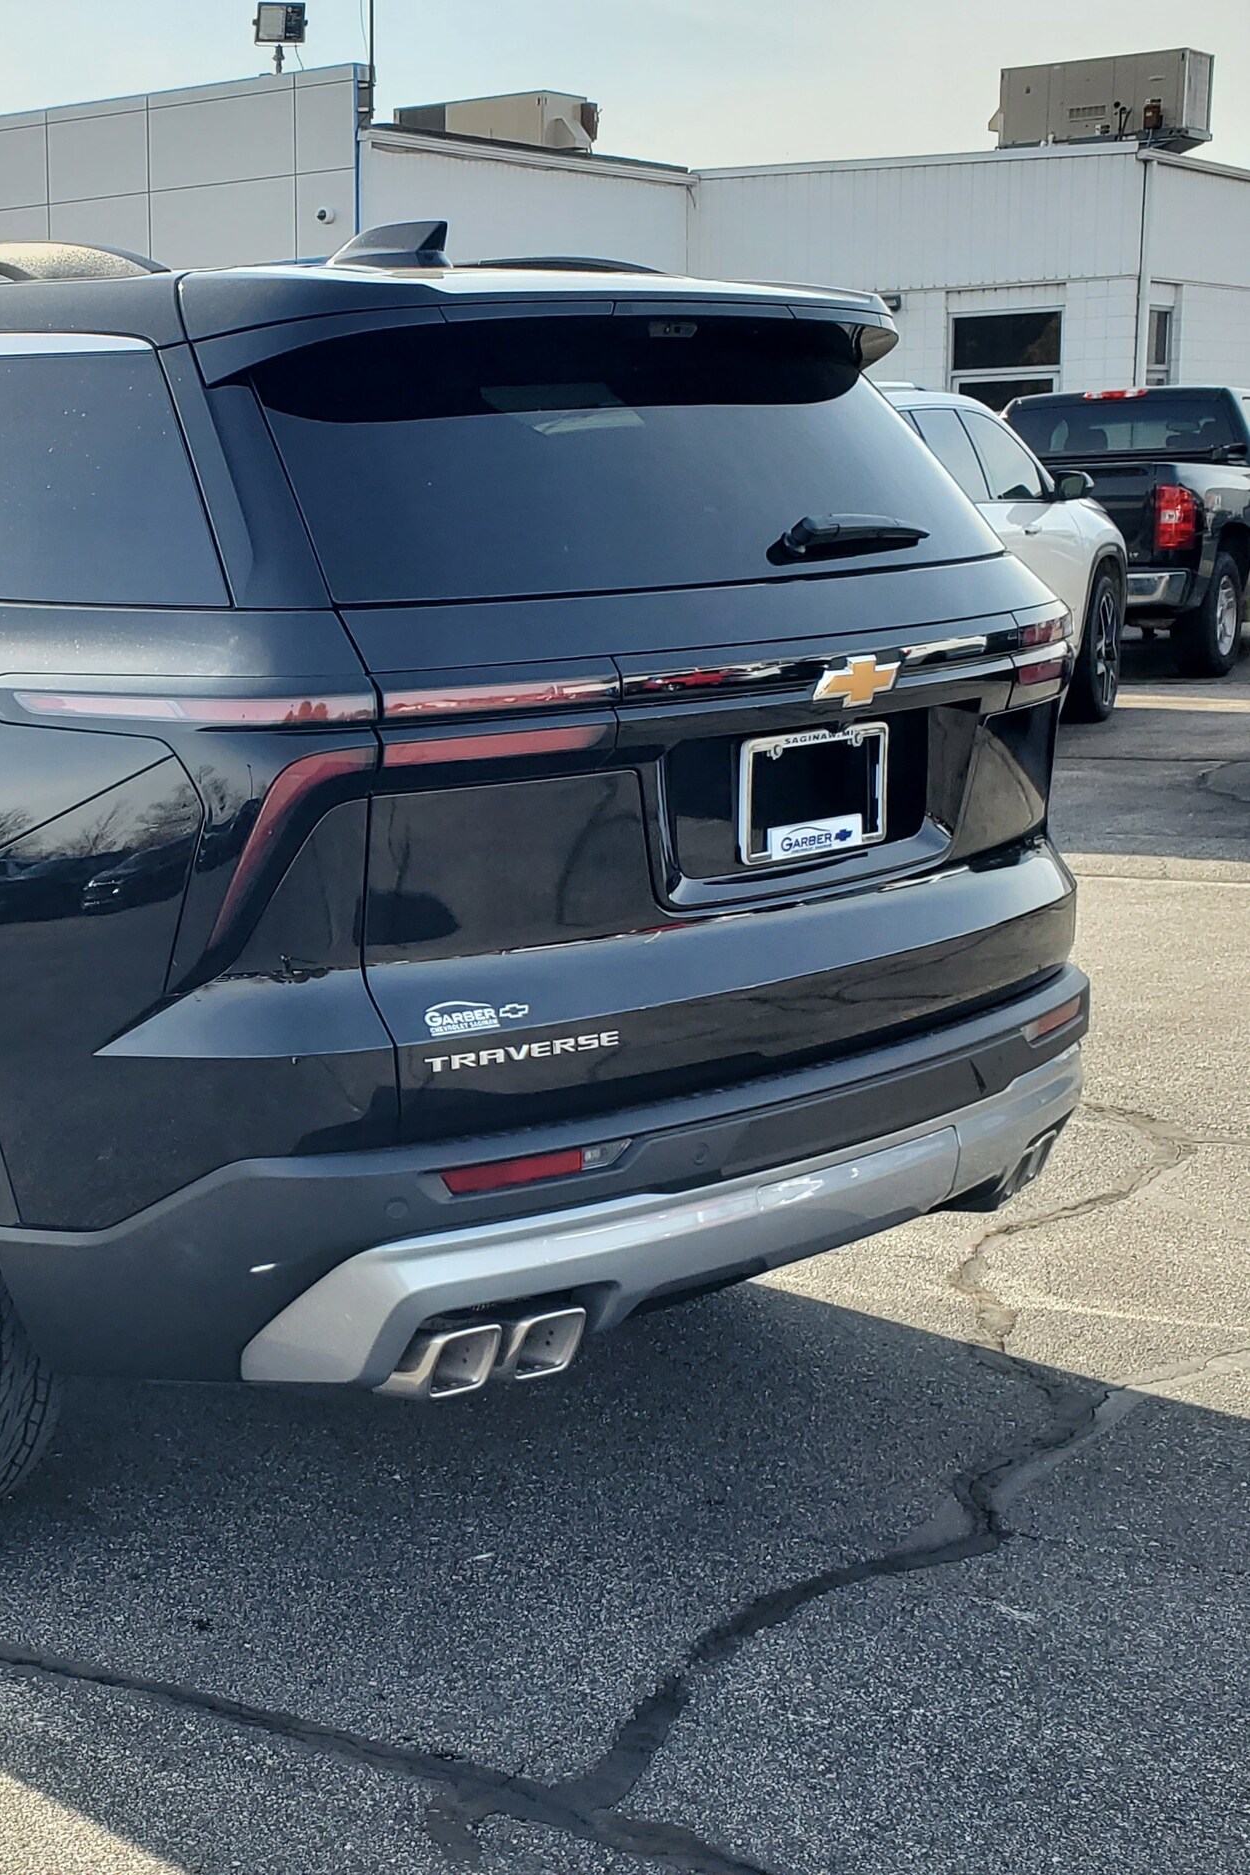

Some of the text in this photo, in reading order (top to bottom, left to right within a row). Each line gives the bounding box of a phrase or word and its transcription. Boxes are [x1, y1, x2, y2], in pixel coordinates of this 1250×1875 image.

[781, 832, 833, 852] GARBER
[425, 1008, 497, 1028] GARBER
[430, 1022, 469, 1035] CHEVROLET
[424, 1030, 620, 1073] TRAVERSE
